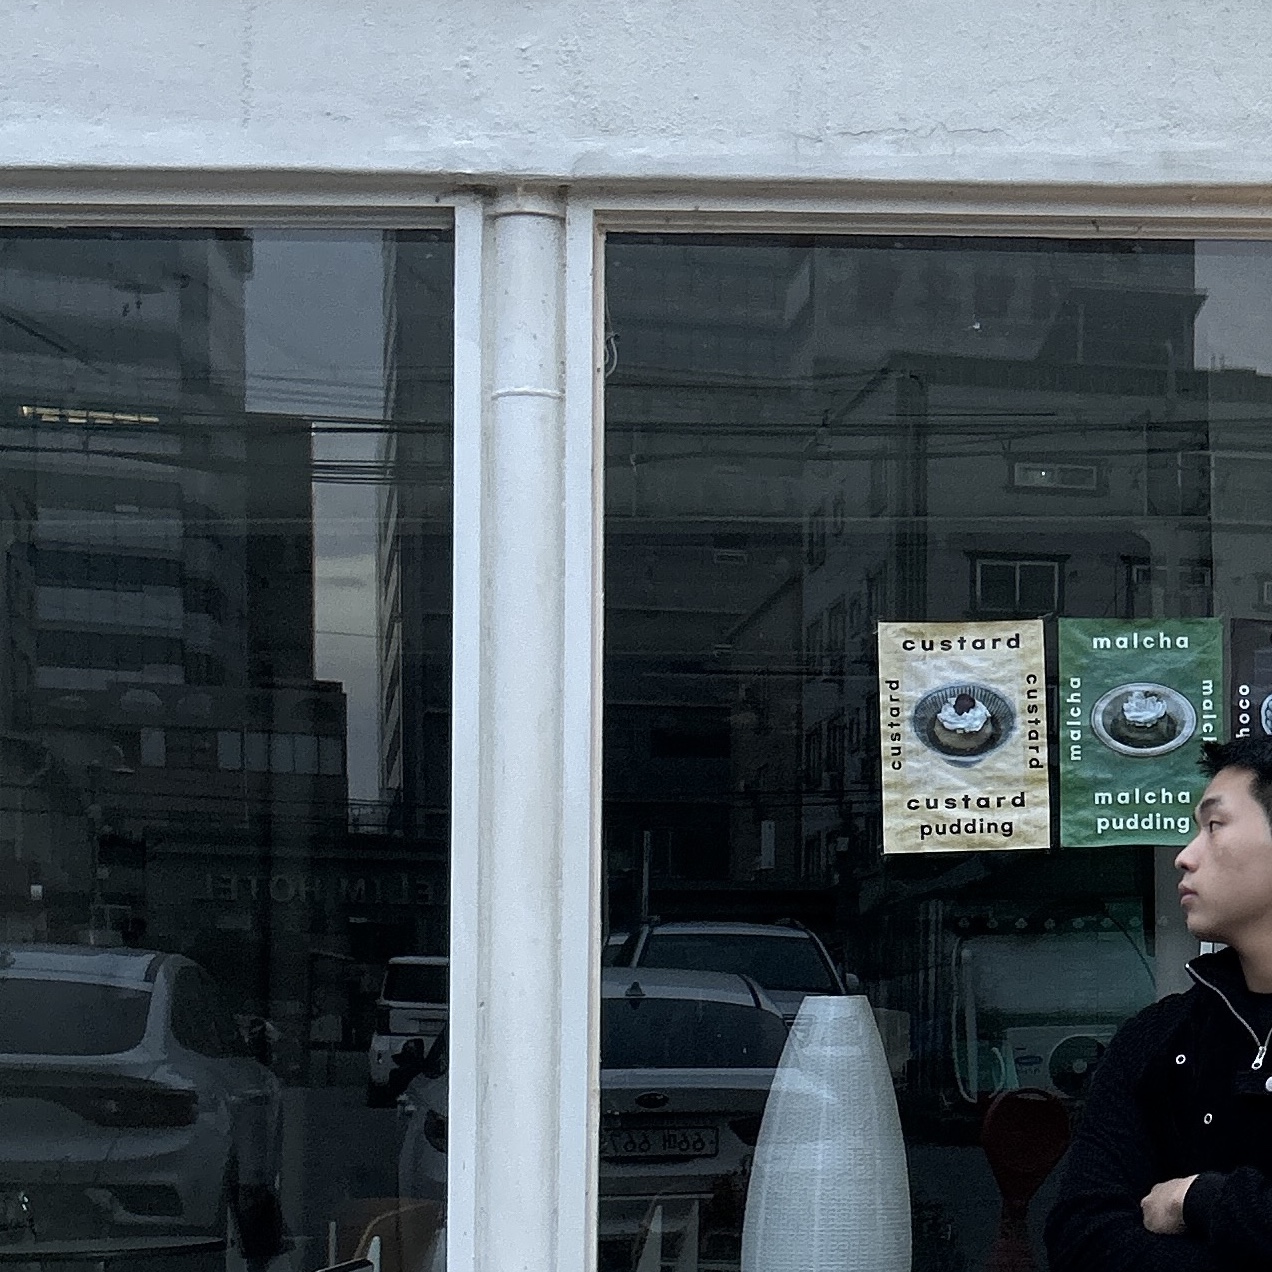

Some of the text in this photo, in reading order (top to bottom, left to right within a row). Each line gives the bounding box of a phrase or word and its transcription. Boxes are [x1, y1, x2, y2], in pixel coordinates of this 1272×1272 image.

[902, 633, 1020, 652] custard
[885, 679, 902, 770] custard
[1026, 674, 1044, 770] custard
[1202, 680, 1217, 741] malc
[1235, 684, 1250, 739] hoco
[907, 791, 1026, 811] custard
[920, 818, 1014, 840] pudding
[1096, 813, 1191, 834] pudding
